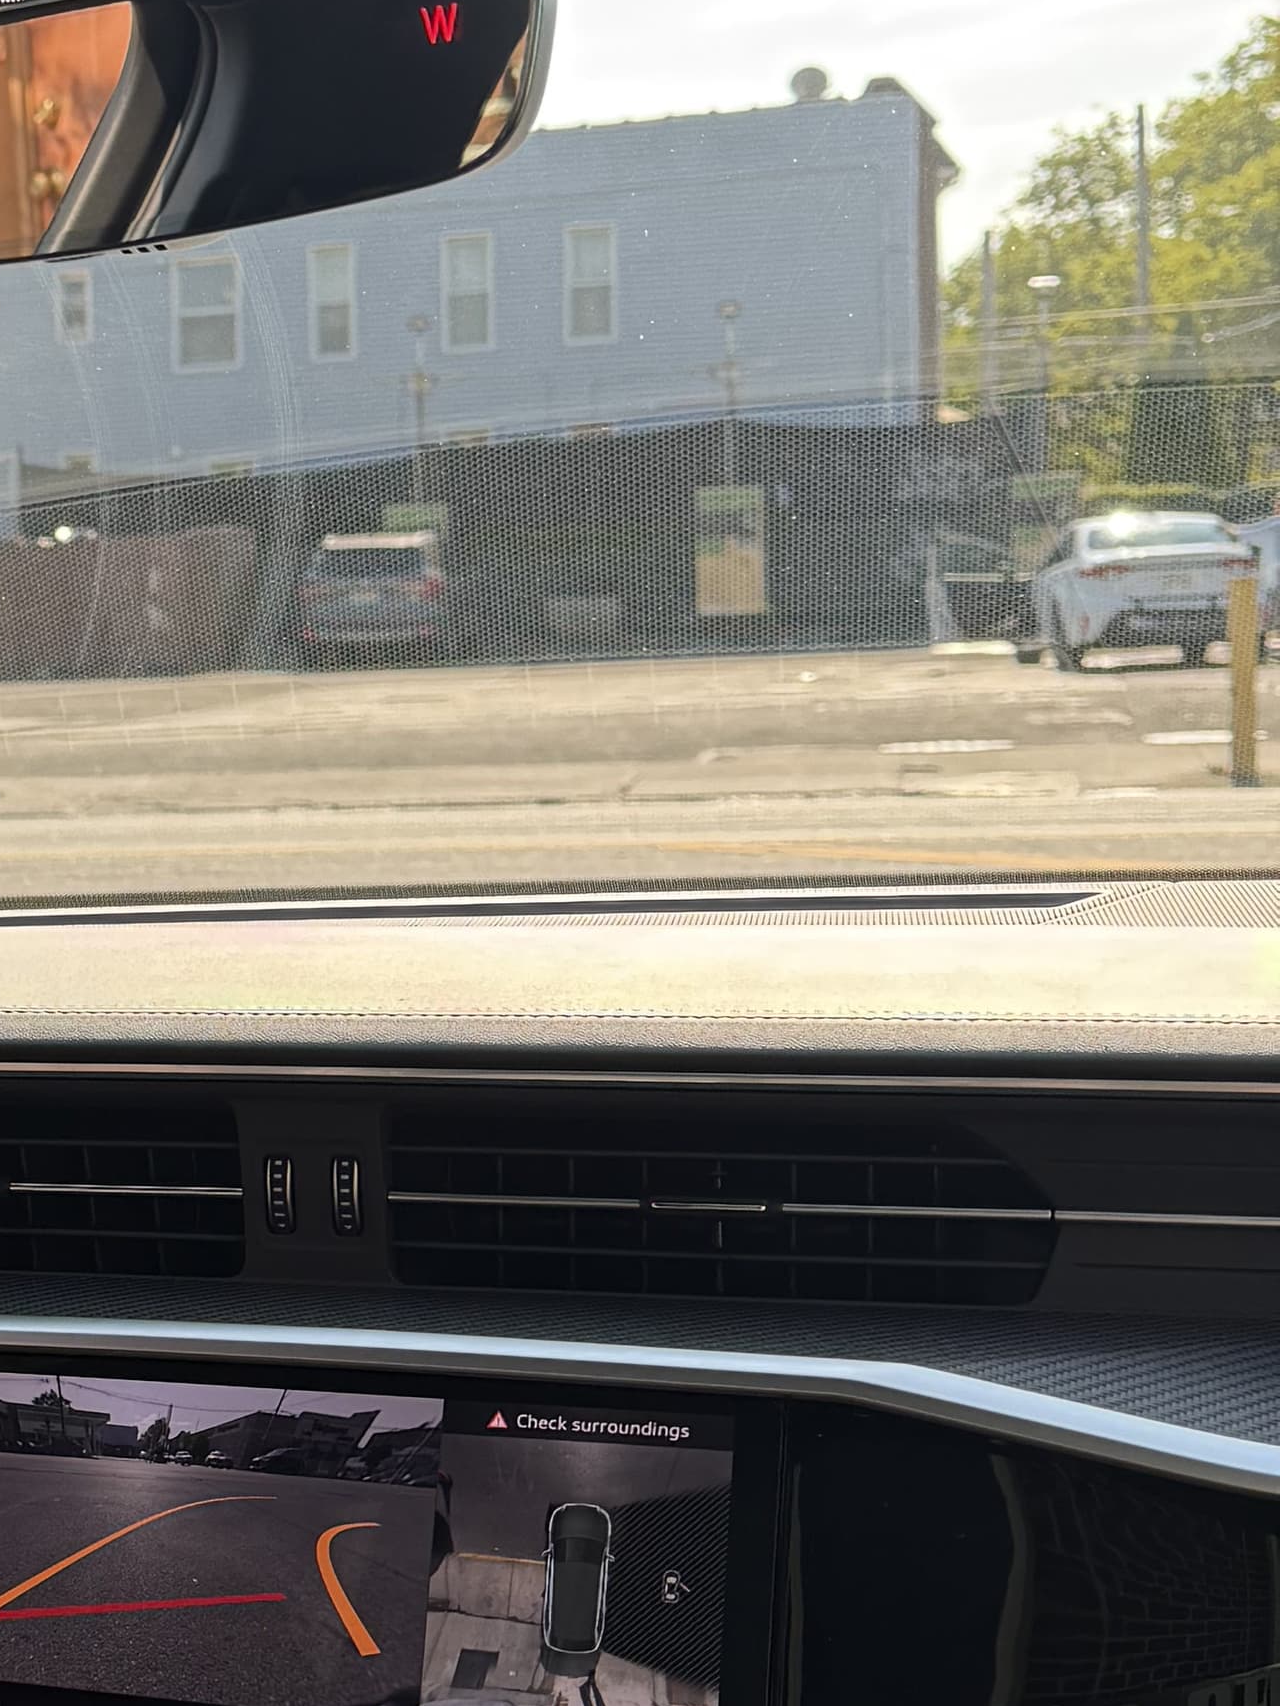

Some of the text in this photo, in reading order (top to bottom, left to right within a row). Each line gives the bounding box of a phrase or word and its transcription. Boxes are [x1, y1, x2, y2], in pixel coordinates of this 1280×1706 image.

[420, 2, 458, 44] W
[516, 1414, 690, 1442] Check surroundings
